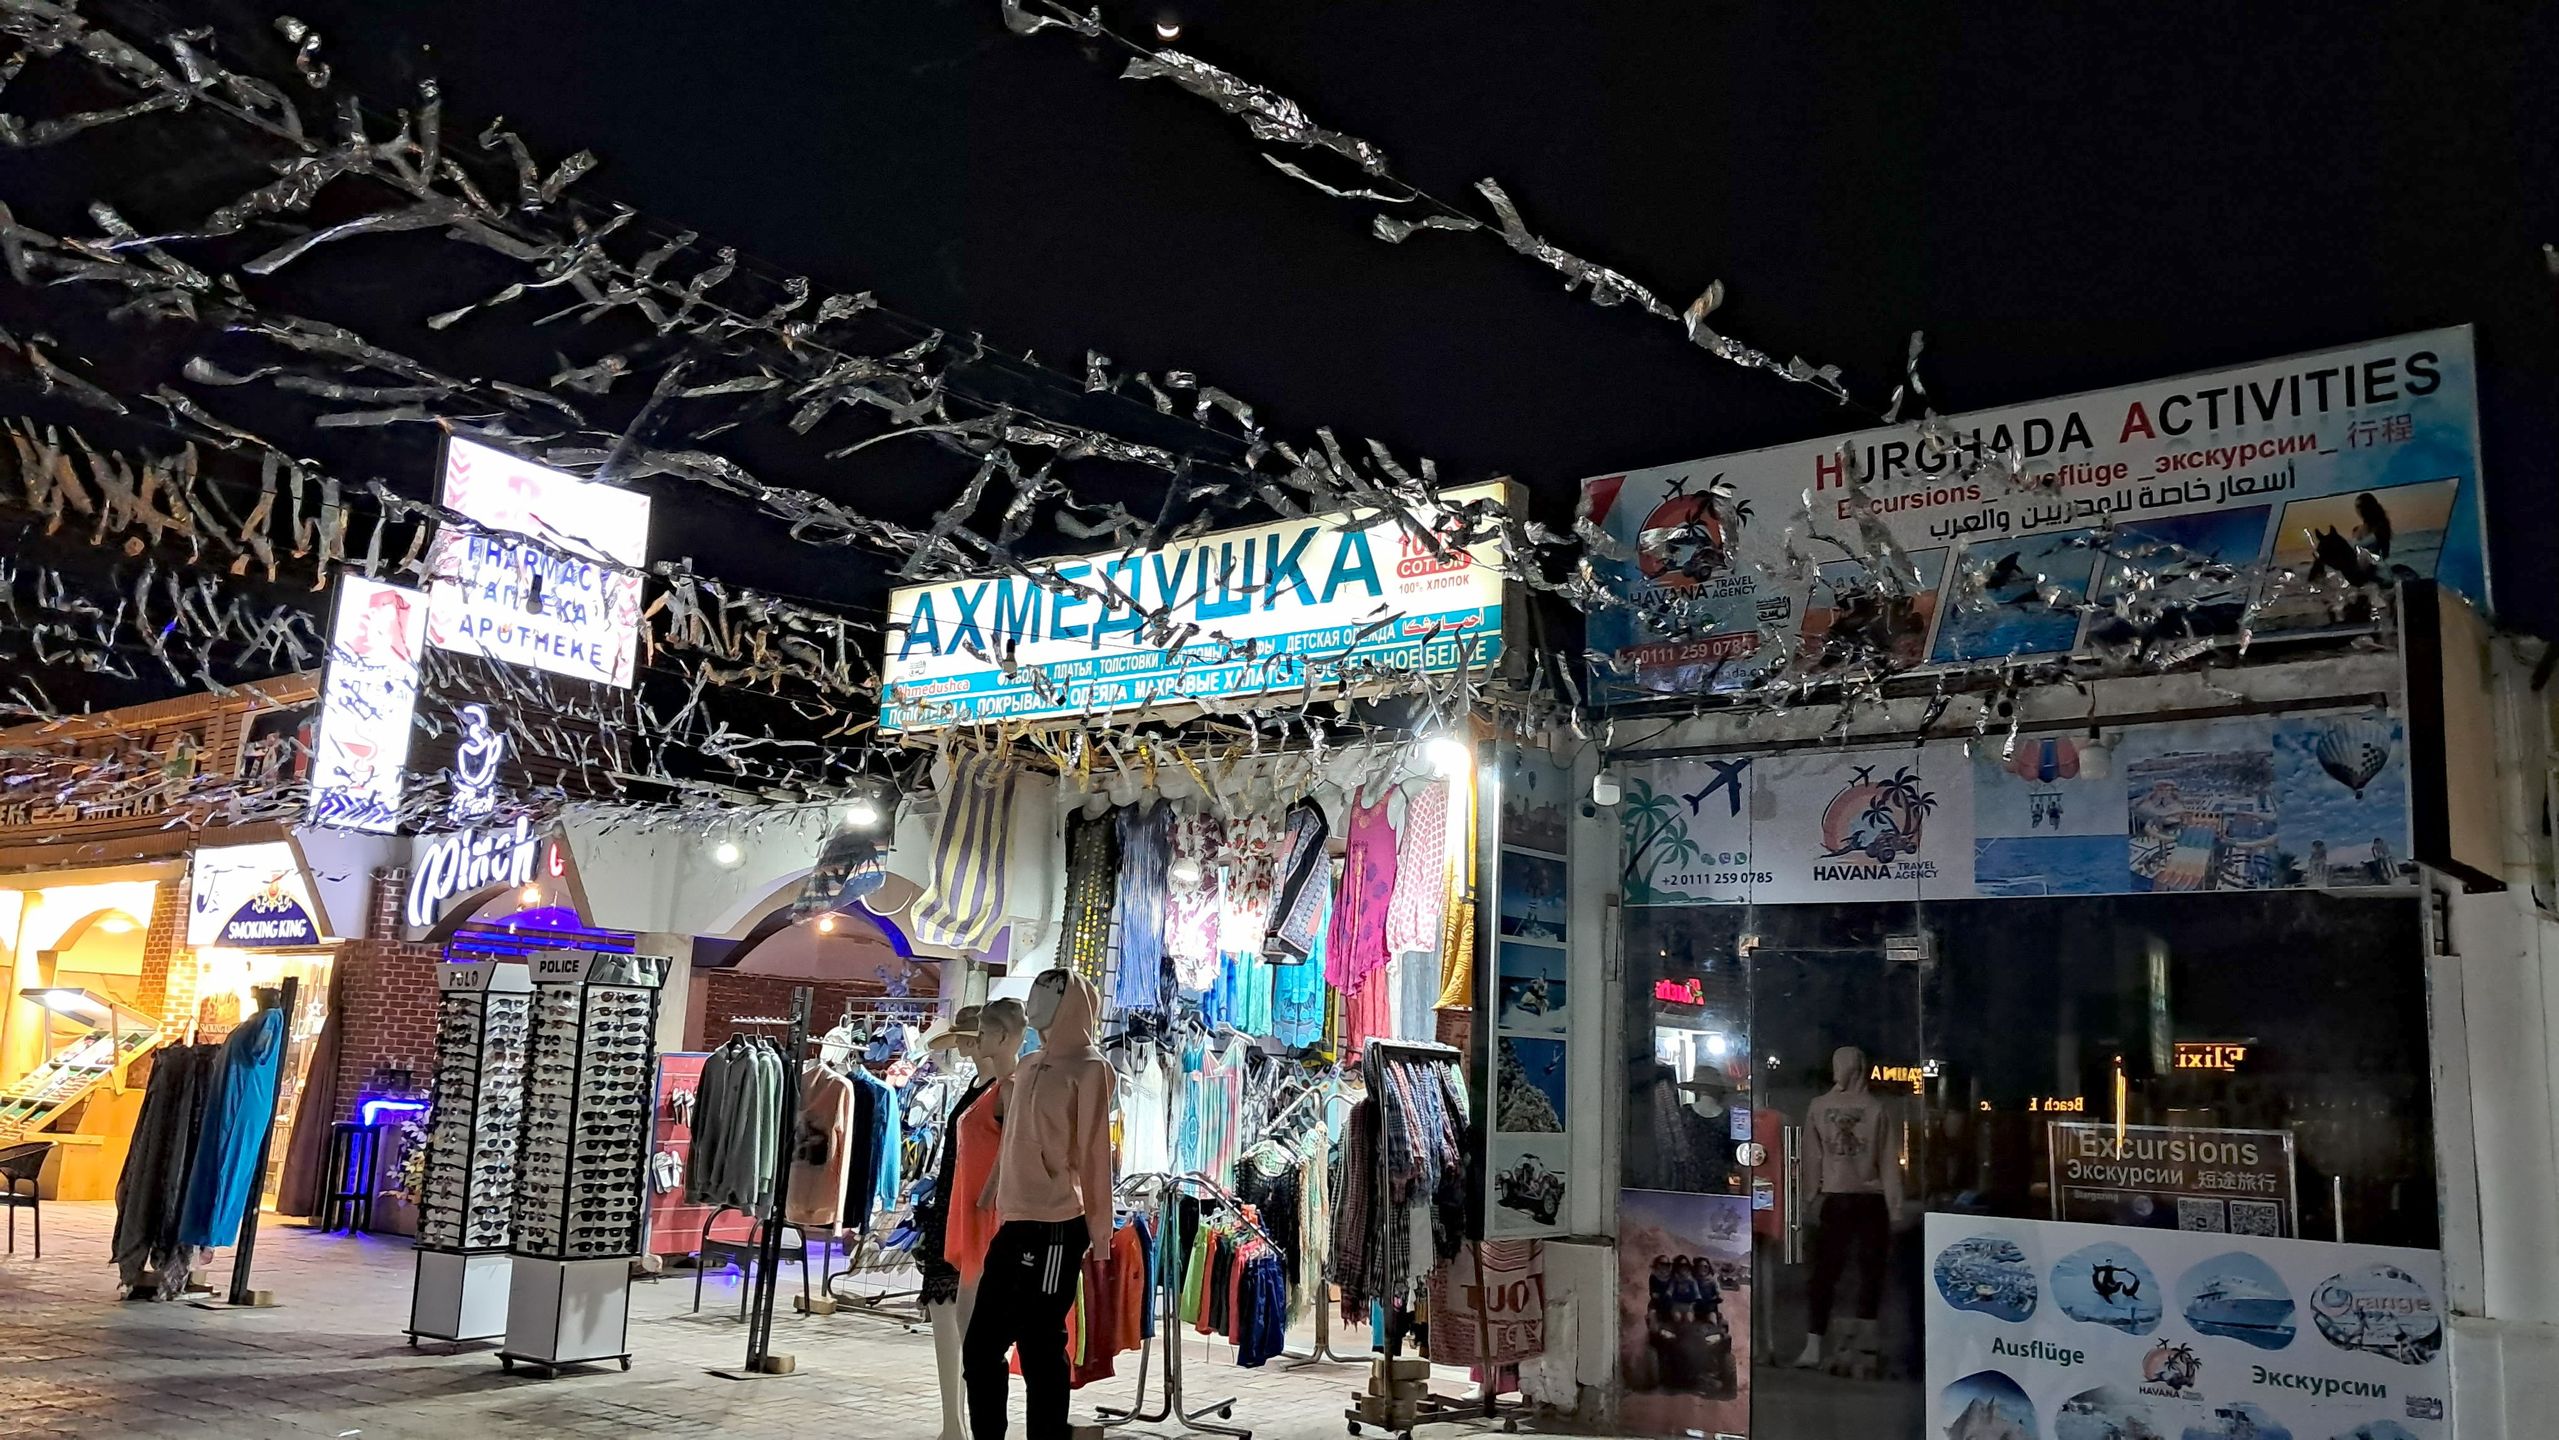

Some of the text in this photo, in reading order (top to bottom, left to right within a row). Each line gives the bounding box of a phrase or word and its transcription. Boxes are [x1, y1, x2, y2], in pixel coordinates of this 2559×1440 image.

[1816, 351, 2441, 490] HURGHADA ACTIVITIES
[2347, 414, 2414, 449] 行程
[2139, 480, 2210, 510] خاصة
[1930, 509, 2010, 541] والعرب
[1426, 574, 1469, 590] ХЛОПОК
[1712, 585, 1757, 599] AGENCY
[1715, 576, 1754, 588] TRAVEL
[897, 526, 1385, 662] АХМЕДУШКА
[459, 614, 603, 666] APOTHEKE
[1286, 632, 1340, 651] ДЕТСКАЯ
[1641, 648, 1674, 664] 0111
[1680, 644, 1708, 660] 259
[1134, 672, 1221, 699] МАХРОВЫЕ
[407, 816, 539, 927] Pinch
[1813, 864, 1892, 881] HAVANA
[1894, 869, 1939, 880] AGENCY
[1898, 861, 1936, 871] TRAVEL
[1680, 874, 1710, 886] 0111
[1714, 873, 1738, 884] 259
[1740, 872, 1773, 883] 0785
[228, 919, 307, 939] SMOKING KING
[539, 959, 580, 974] POLICE
[2079, 1129, 2259, 1166] Excursions
[2067, 1159, 2184, 1187] Экскурсии
[1991, 1336, 2085, 1367] Ausflüge
[2138, 1386, 2180, 1399] HAVANA
[2251, 1364, 2387, 1399] Экскурсии
